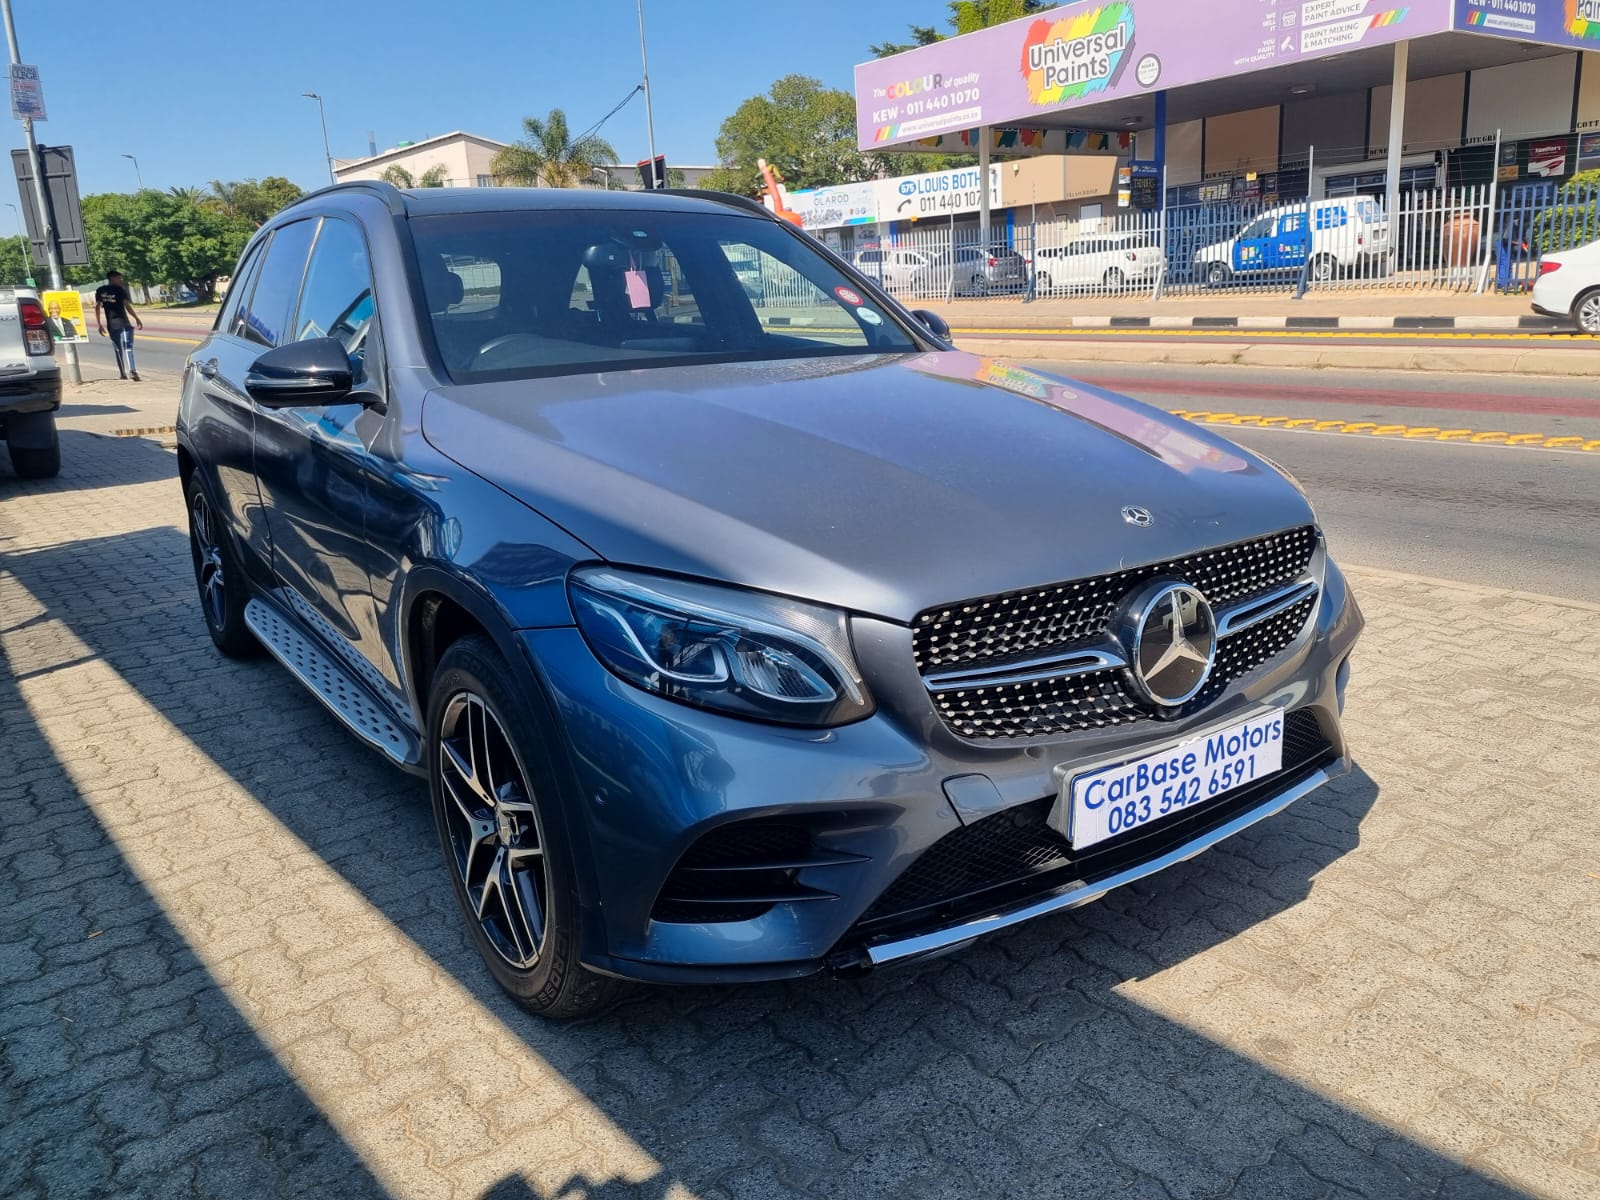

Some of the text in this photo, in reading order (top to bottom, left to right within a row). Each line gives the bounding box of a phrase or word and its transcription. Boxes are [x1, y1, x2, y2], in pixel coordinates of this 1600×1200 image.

[1304, 0, 1336, 14] EXPERT
[1304, 3, 1361, 22] PAINT ADVICE
[1504, 0, 1519, 12] 440
[1518, 3, 1536, 15] 1070
[1303, 22, 1359, 40] PAINT MIXING
[1310, 32, 1353, 48] MATCHING
[1030, 25, 1124, 68] Universal
[1262, 39, 1275, 47] YOU
[1249, 52, 1275, 63] QUALITY
[1046, 56, 1108, 87] Paints
[873, 71, 981, 100] The COLOUR of quality
[872, 106, 898, 124] KEW
[906, 99, 924, 115] 011
[925, 94, 948, 111] 440
[949, 87, 980, 106] 1070
[901, 171, 982, 195] 575 LOUIS BOTH
[920, 195, 936, 212] 011
[939, 193, 961, 210] 440
[1084, 718, 1282, 810] CarBase Motors
[1107, 754, 1256, 834] 083 542 6591
